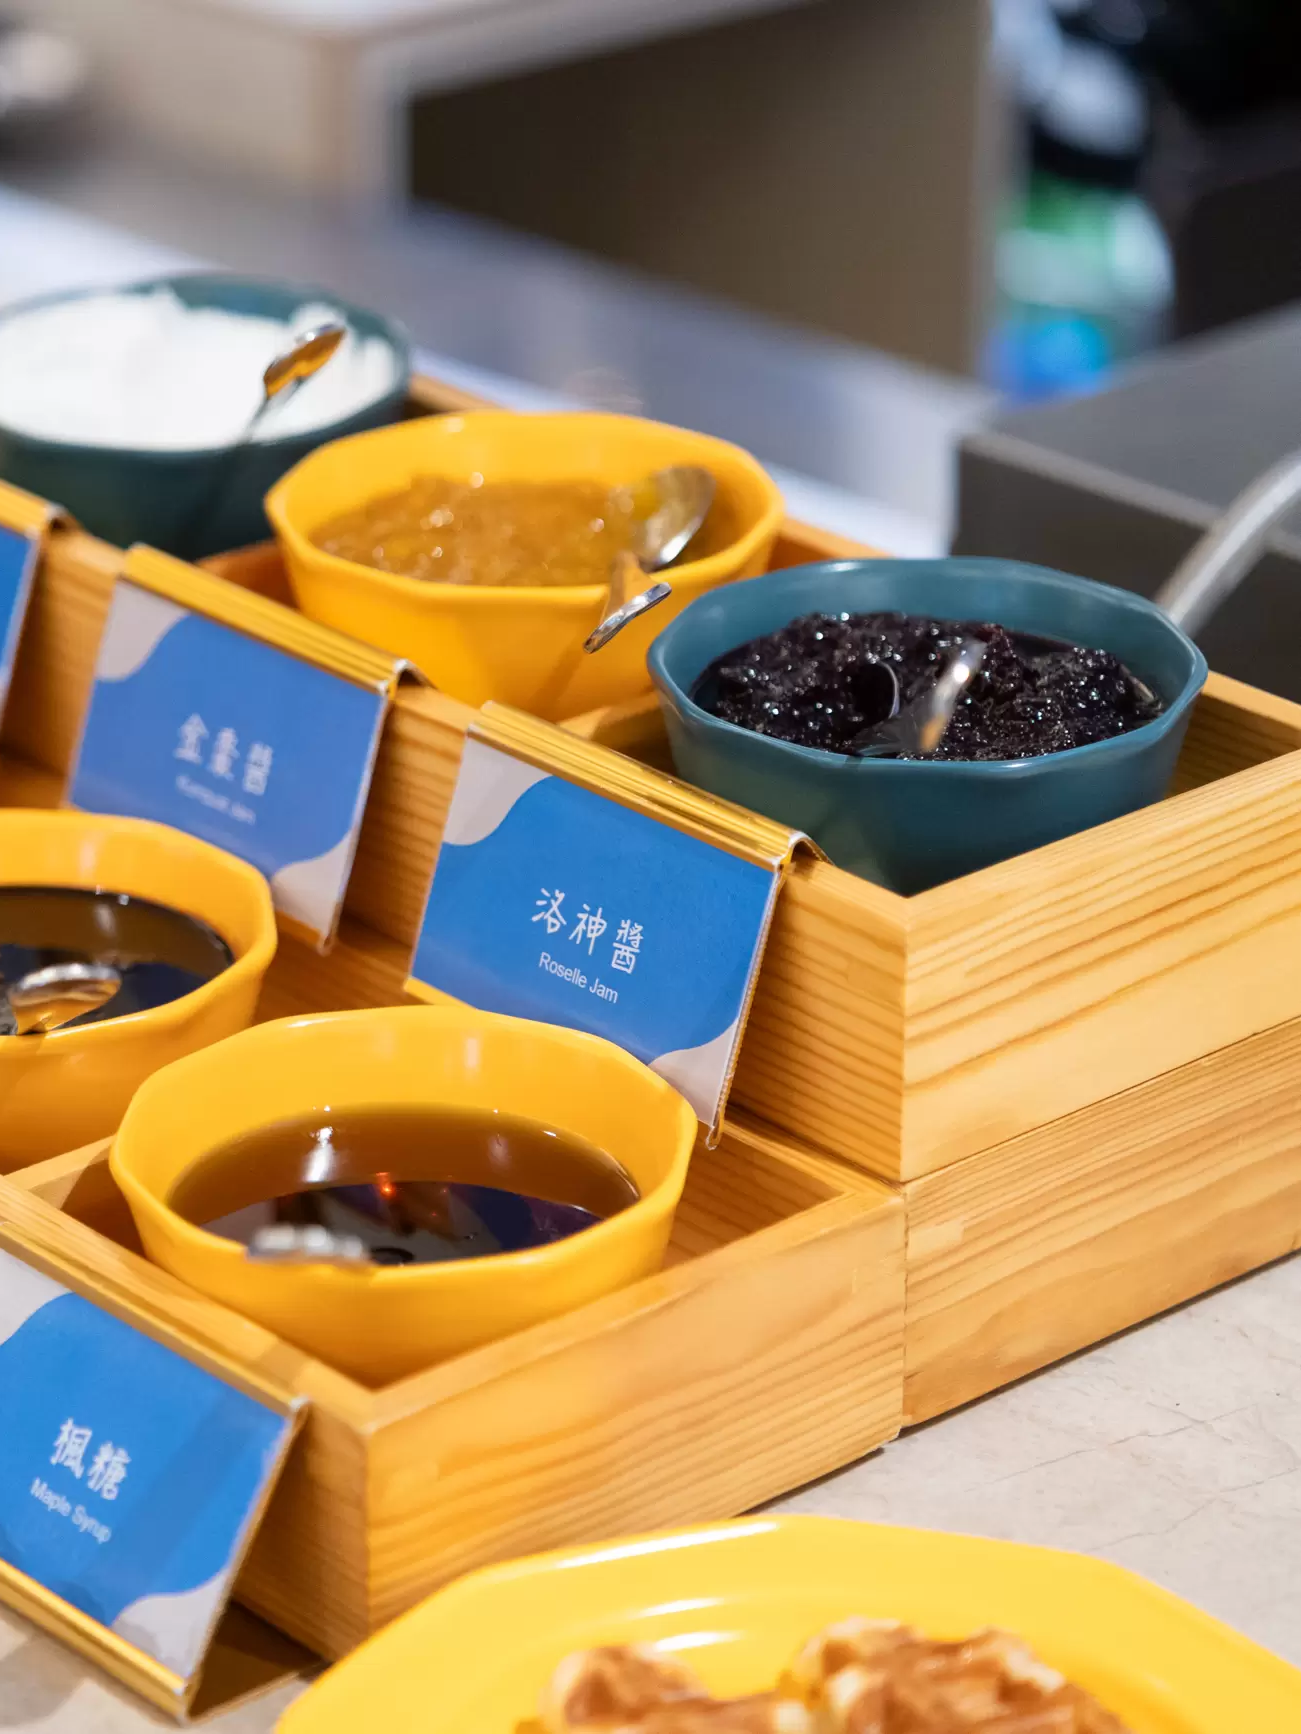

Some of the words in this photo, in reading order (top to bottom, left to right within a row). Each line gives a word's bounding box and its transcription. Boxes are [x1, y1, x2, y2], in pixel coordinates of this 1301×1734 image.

[531, 887, 644, 974] 洛神醬
[538, 951, 588, 989] Roselle
[588, 978, 619, 1004] Jam
[50, 1418, 131, 1501] 楓糖
[30, 1478, 72, 1516] Maple
[71, 1504, 112, 1544] Syrup
